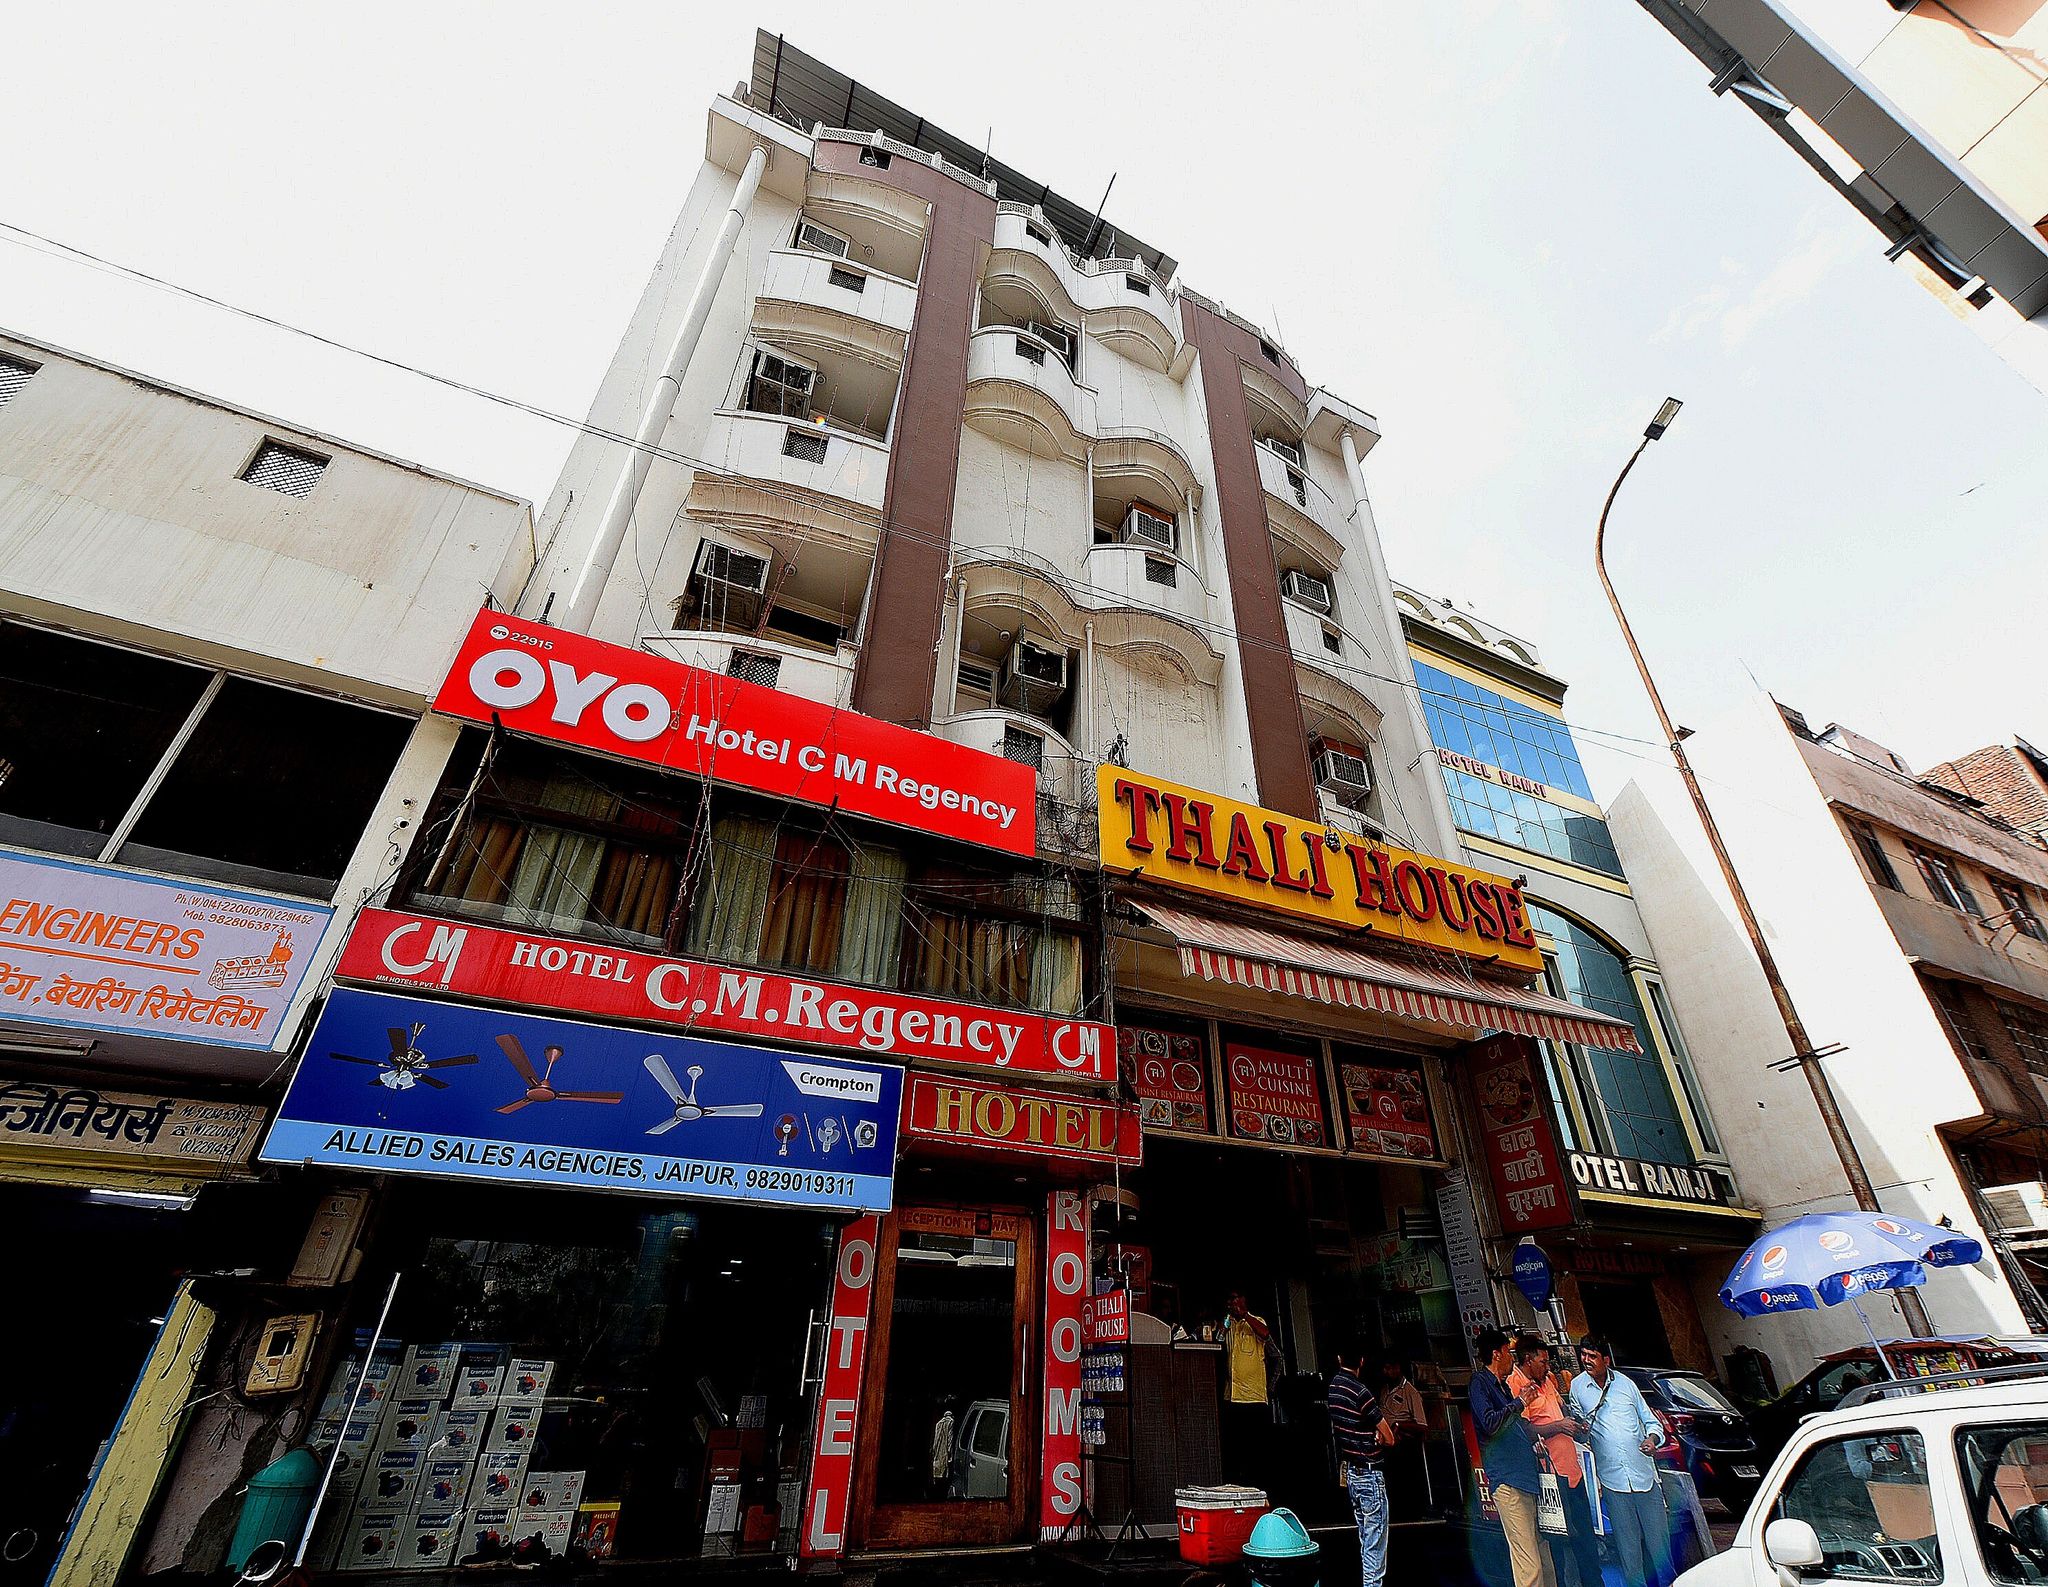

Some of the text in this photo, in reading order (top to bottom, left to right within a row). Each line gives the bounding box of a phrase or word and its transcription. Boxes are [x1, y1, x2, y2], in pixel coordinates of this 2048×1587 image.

[510, 632, 553, 650] 22915
[468, 649, 1017, 830] OYO Hotel C M Regency
[1438, 749, 1547, 798] HOTEL RAMJI
[1115, 778, 1537, 950] THALI HOUSE
[183, 909, 205, 921] Mob.
[0, 899, 205, 960] ENGINEERS
[381, 921, 466, 983] CM
[509, 941, 635, 984] HOTEL
[389, 977, 418, 987] HOTELS
[1052, 1023, 1102, 1072] CM
[800, 1071, 874, 1092] Crompton
[1259, 1060, 1311, 1081] MULTI
[1135, 1086, 1204, 1102] UISINE RESTAURANT
[1258, 1075, 1313, 1098] CUISINE
[1233, 1091, 1318, 1119] RESTAURANT
[934, 1087, 1117, 1152] HOTEL
[1497, 1126, 1536, 1153] दाल
[323, 1130, 856, 1198] ALLIED SALES AGENCIES, JAIPUR, 9829019311
[1502, 1150, 1546, 1182] बाटी
[1570, 1153, 1717, 1200] OTEL RAMJI
[991, 1219, 1015, 1232] WAY
[1515, 1261, 1544, 1275] magicpin
[1856, 1269, 1890, 1287] pepsi
[1095, 1295, 1125, 1317] THALI
[1771, 1293, 1800, 1305] pepsi
[1095, 1317, 1125, 1339] HOUSE
[1048, 1190, 1084, 1515] ROOMS
[470, 1368, 495, 1376] Crompton
[519, 1362, 544, 1370] Crompton
[808, 1239, 875, 1552] OTEL
[381, 1455, 414, 1466] Crompton
[478, 1512, 508, 1523] Crompton
